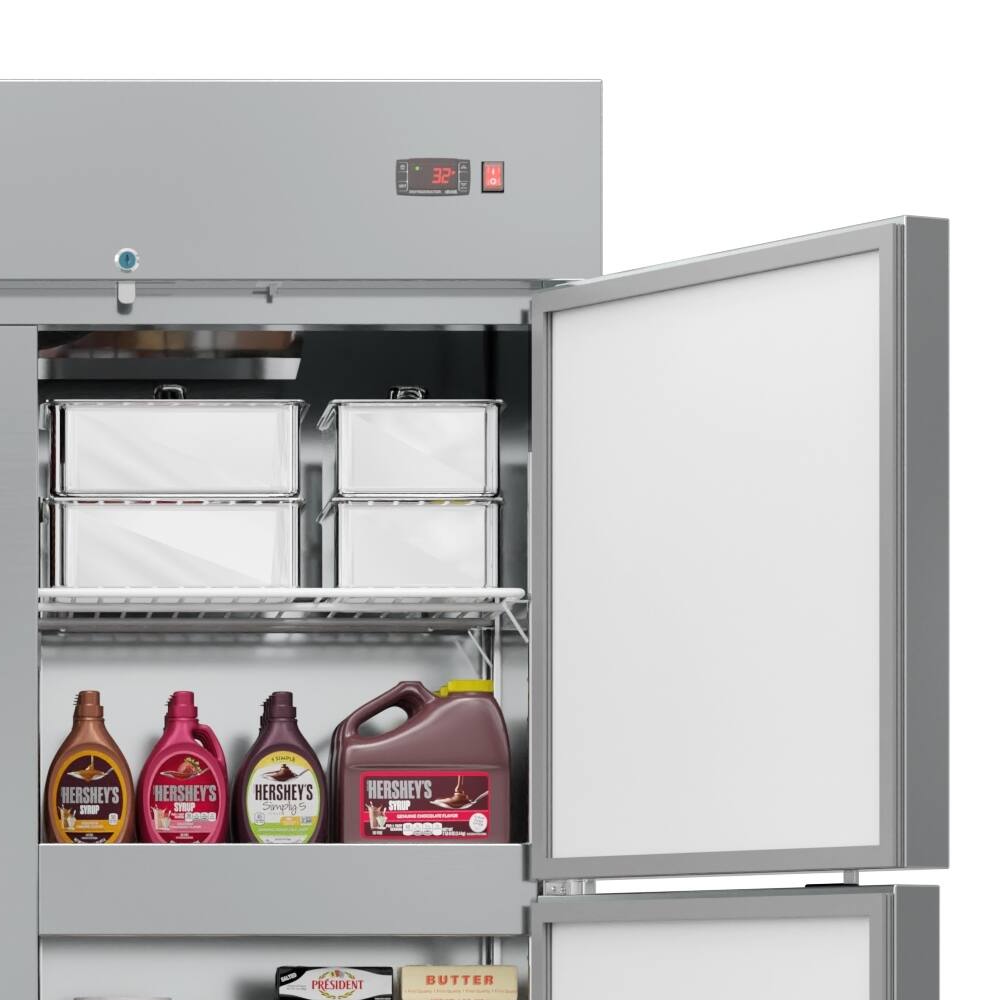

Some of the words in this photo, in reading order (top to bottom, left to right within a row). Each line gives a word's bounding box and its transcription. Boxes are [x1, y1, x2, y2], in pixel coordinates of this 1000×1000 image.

[62, 786, 120, 804] HERSHEY'S
[154, 784, 217, 802] HERSHEY'S
[255, 784, 313, 800] HERSHEY'S
[367, 779, 432, 799] HERSHEY'S
[79, 805, 100, 815] SYRUP
[173, 801, 196, 812] SYRUP
[262, 801, 297, 815] Simply
[299, 802, 307, 811] 5
[388, 800, 411, 811] SYRUP
[312, 979, 364, 991] PRÉSIDENT
[425, 975, 494, 985] BUTTER
